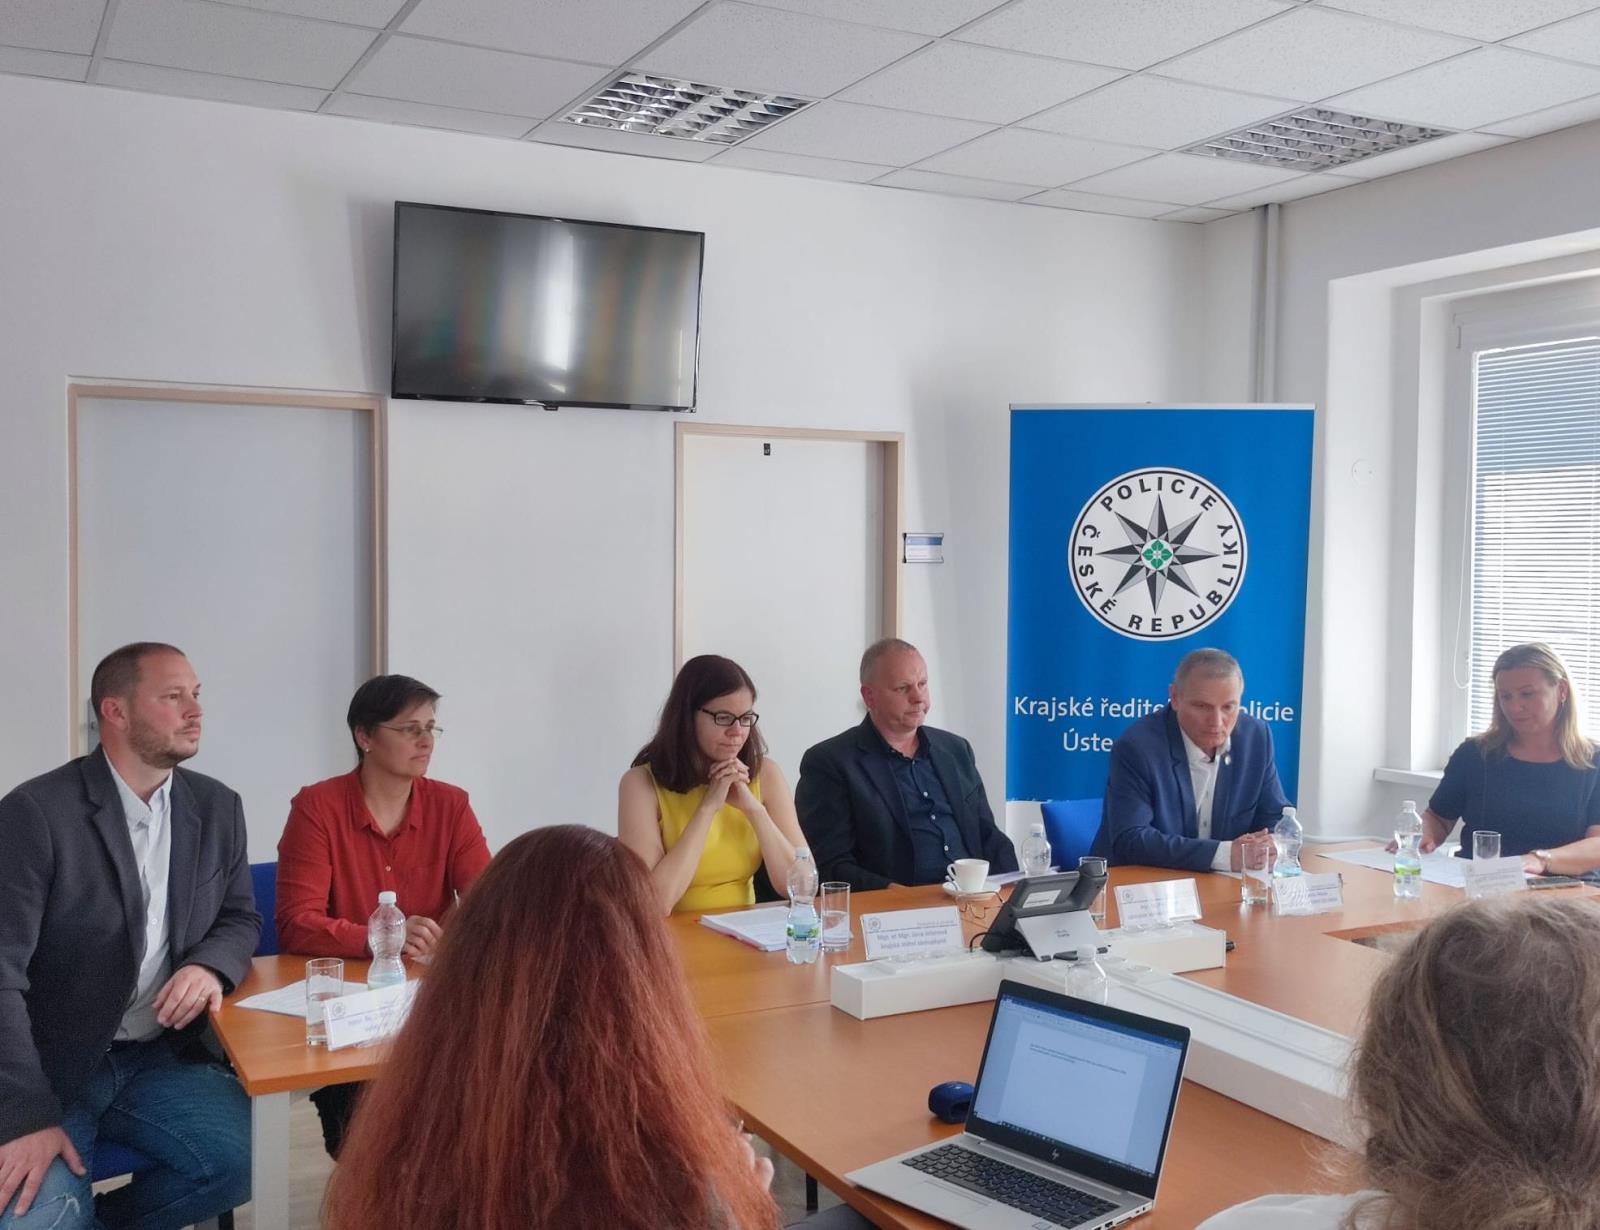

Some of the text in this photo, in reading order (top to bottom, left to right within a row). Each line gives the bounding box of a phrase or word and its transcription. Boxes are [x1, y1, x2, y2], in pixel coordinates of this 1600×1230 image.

[1100, 476, 1217, 512] POLICIE
[1077, 523, 1239, 633] ČESKÉ REPUBLIKY
[1014, 696, 1094, 722] Krajské
[1100, 697, 1171, 718] ředite
[1063, 727, 1114, 752] Úste
